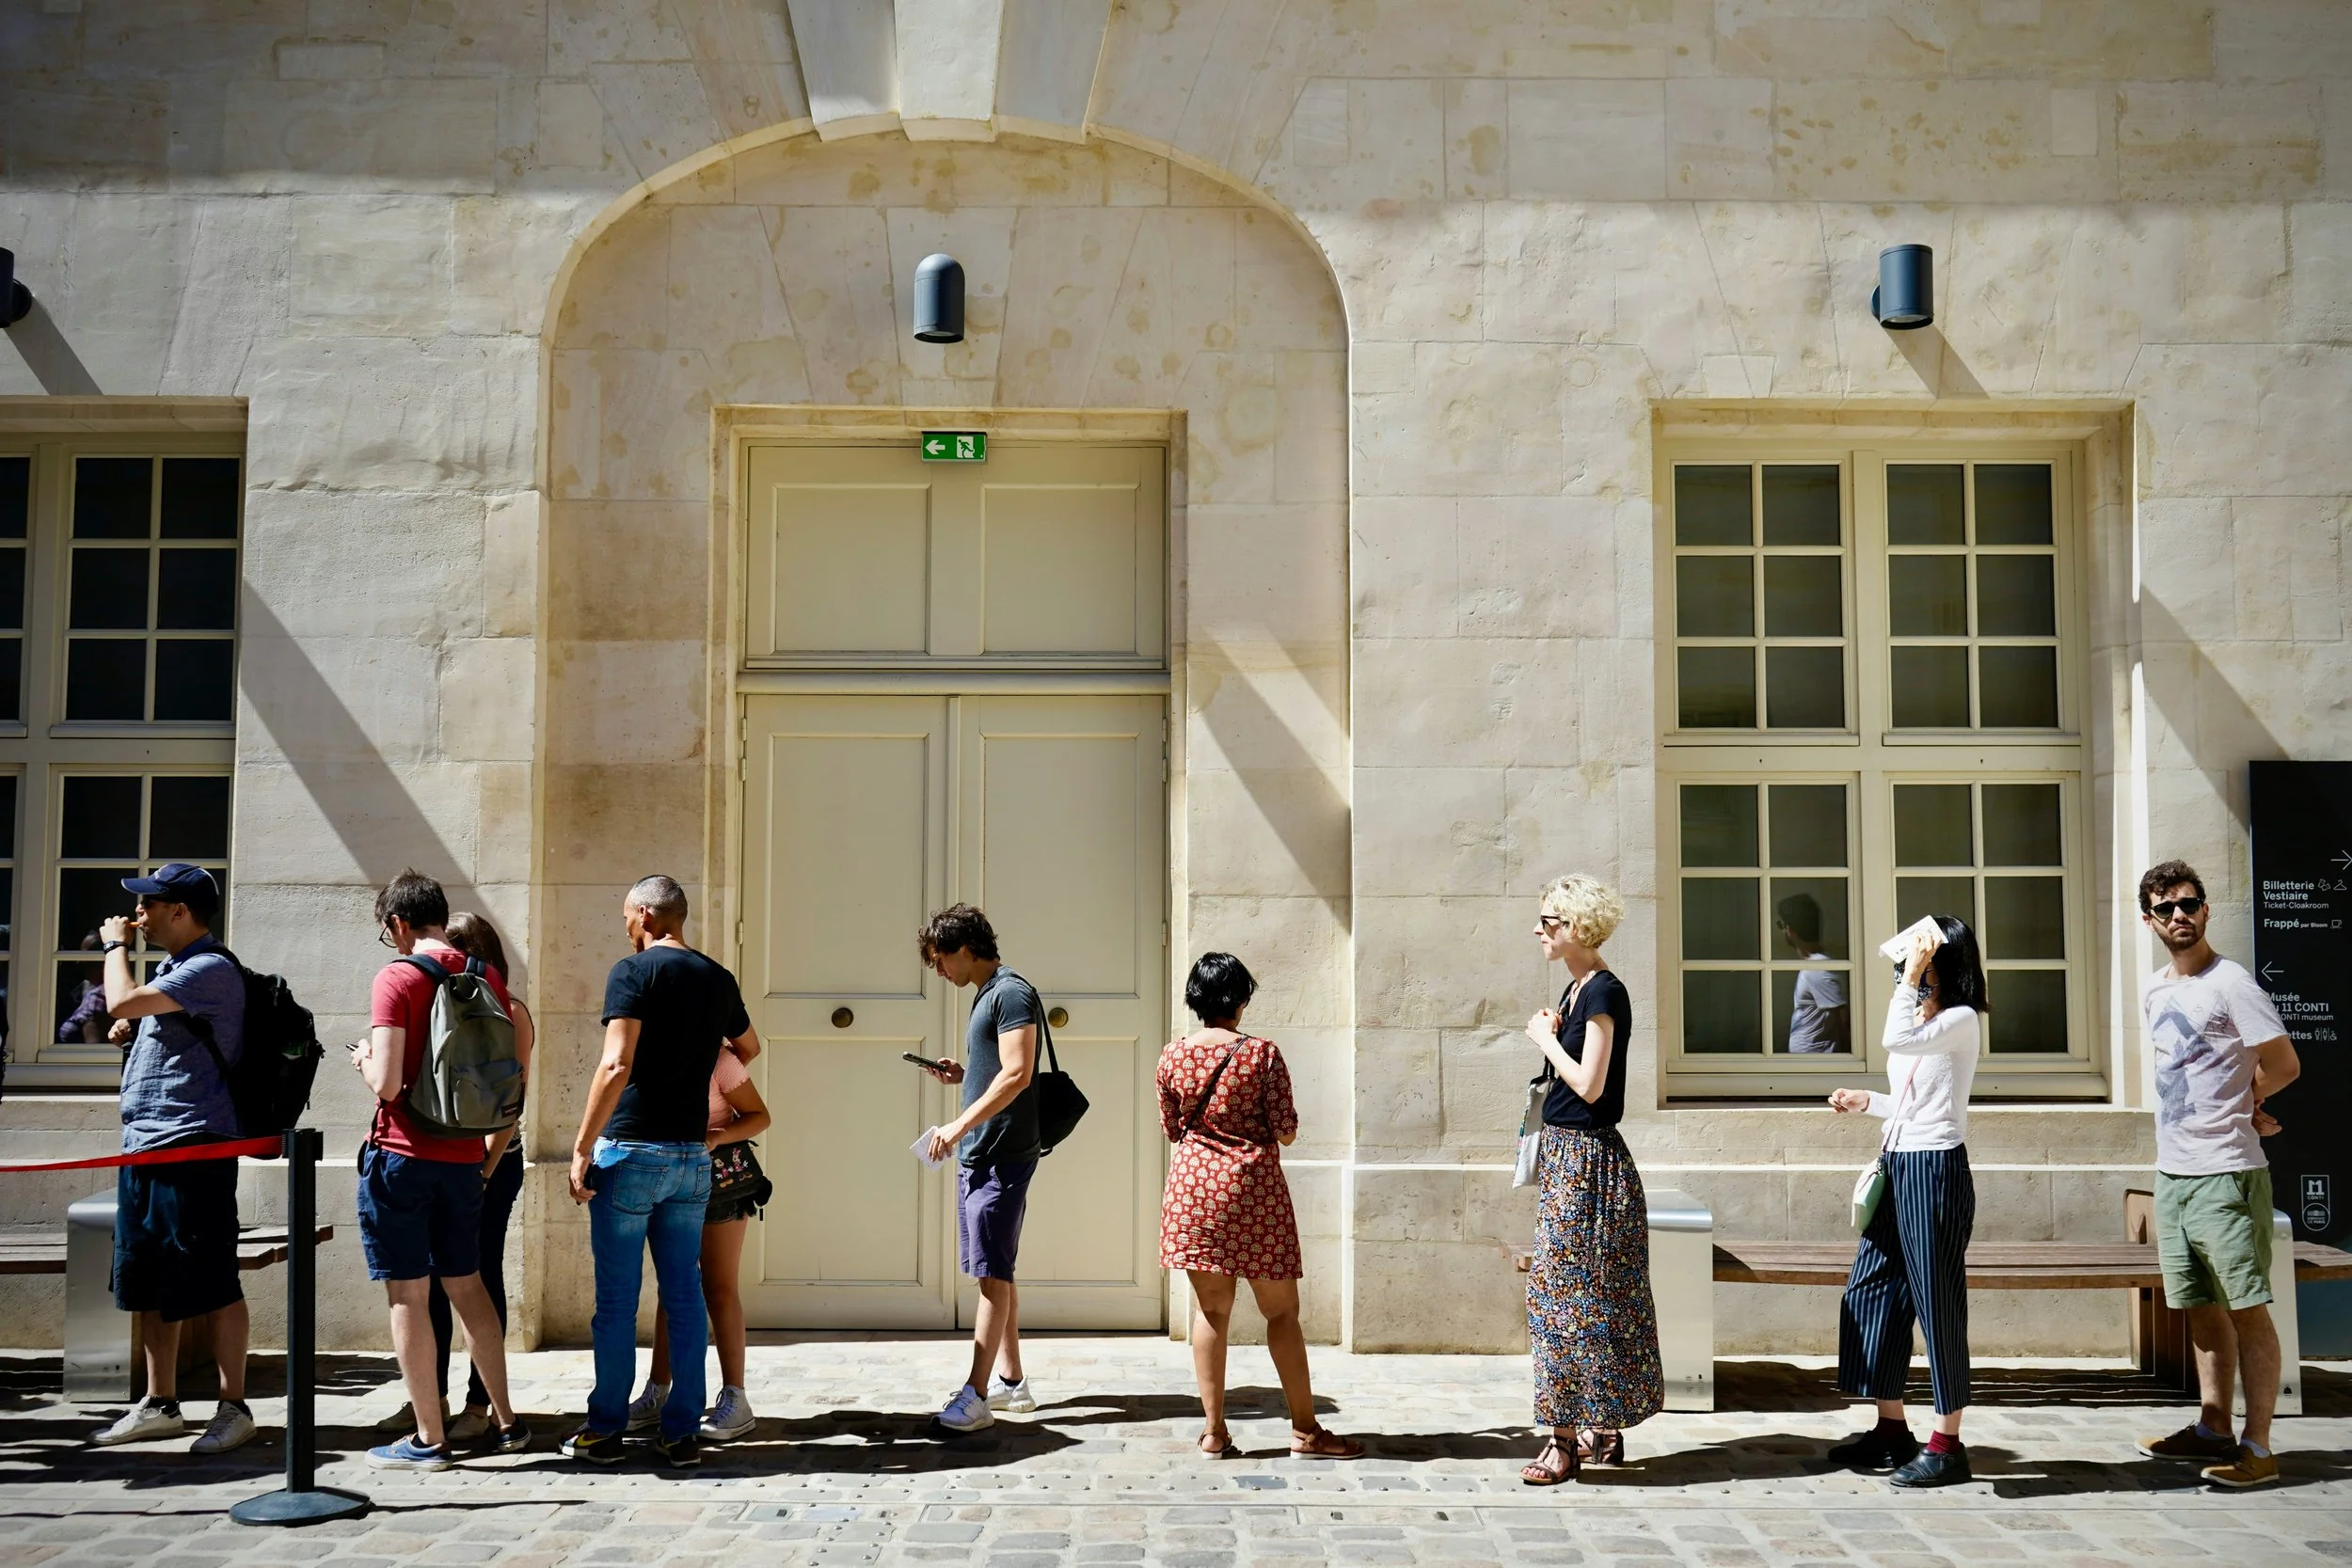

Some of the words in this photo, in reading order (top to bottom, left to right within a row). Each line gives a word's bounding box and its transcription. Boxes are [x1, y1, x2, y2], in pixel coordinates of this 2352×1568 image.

[2263, 880, 2314, 890] Billetterie
[2263, 891, 2309, 900] Vestiaire
[2263, 901, 2329, 910] Ticket-Cloakroom
[2264, 918, 2299, 930] Frappé
[2281, 1003, 2293, 1012] 11
[2295, 1003, 2329, 1012] CONTI
[2287, 1030, 2312, 1039] ettes
